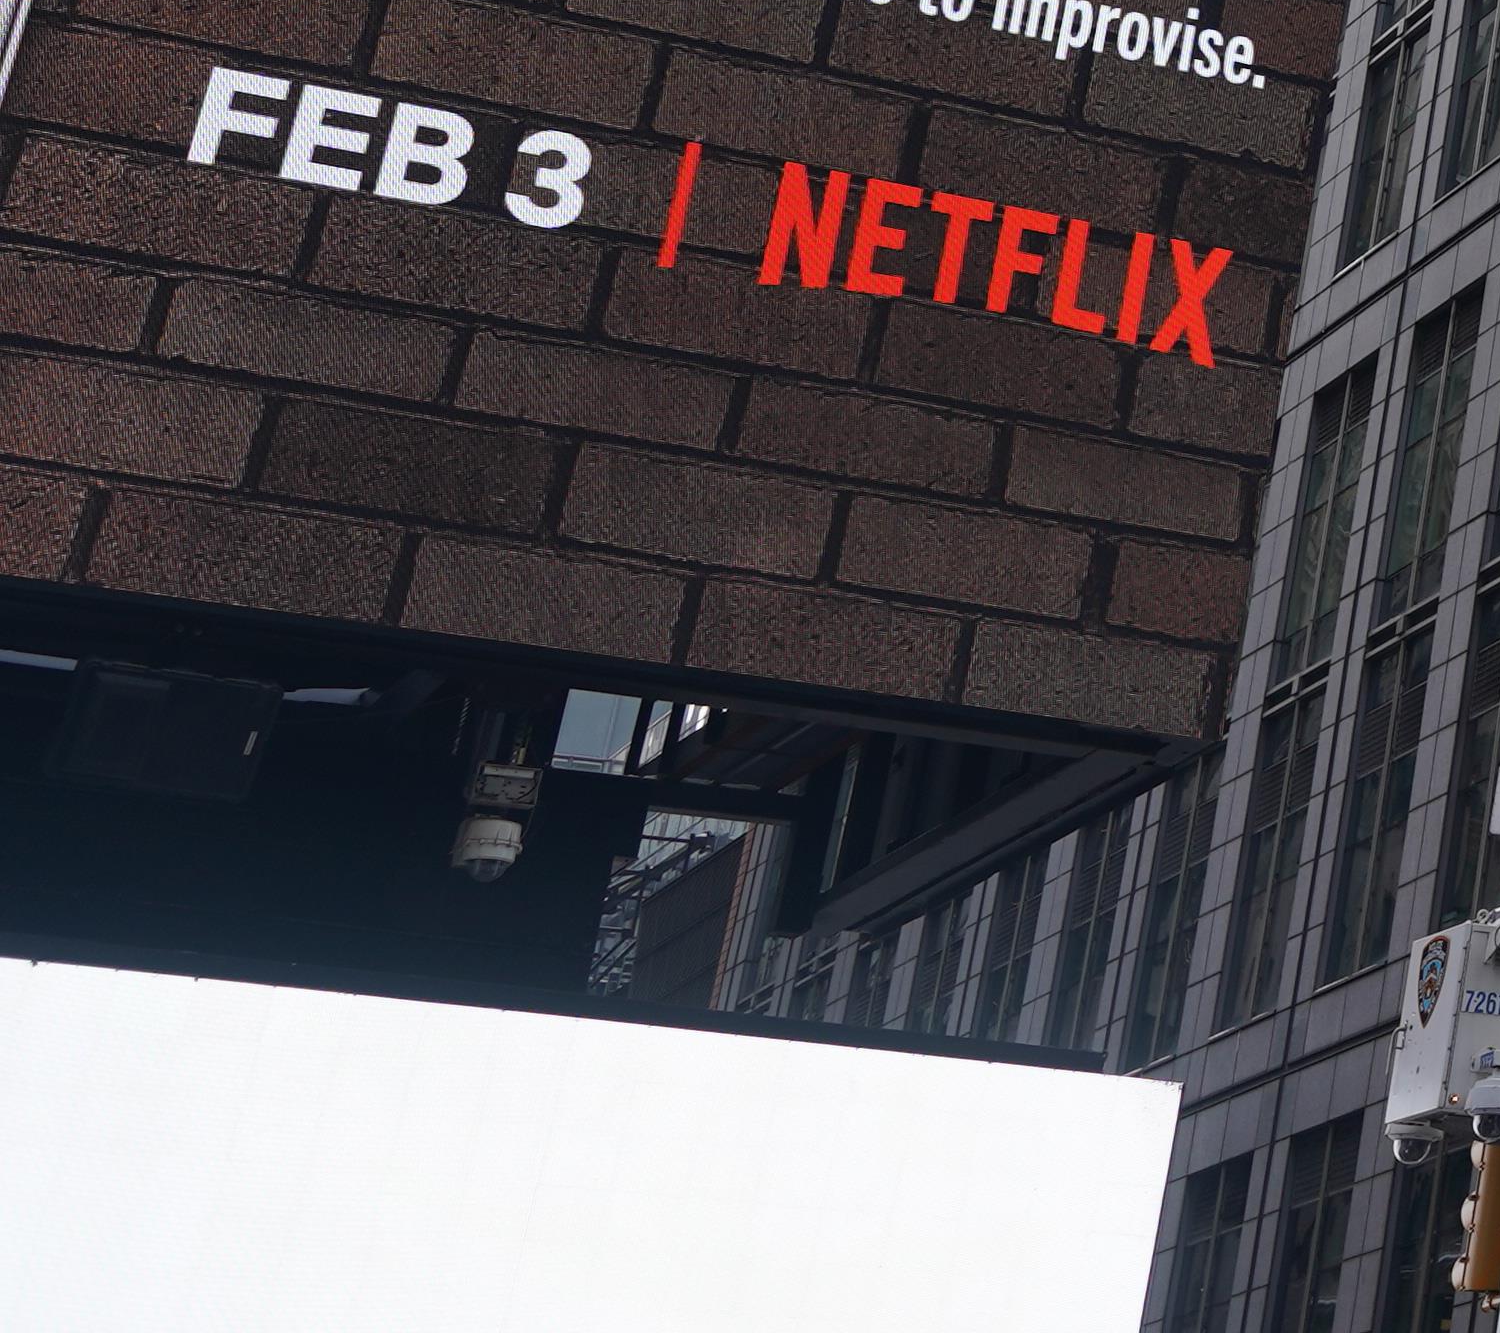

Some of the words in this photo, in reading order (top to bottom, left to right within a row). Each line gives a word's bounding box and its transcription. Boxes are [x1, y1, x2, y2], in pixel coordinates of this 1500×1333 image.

[187, 66, 476, 207] FEB
[504, 129, 593, 229] 3
[758, 159, 1235, 370] NETFLIX
